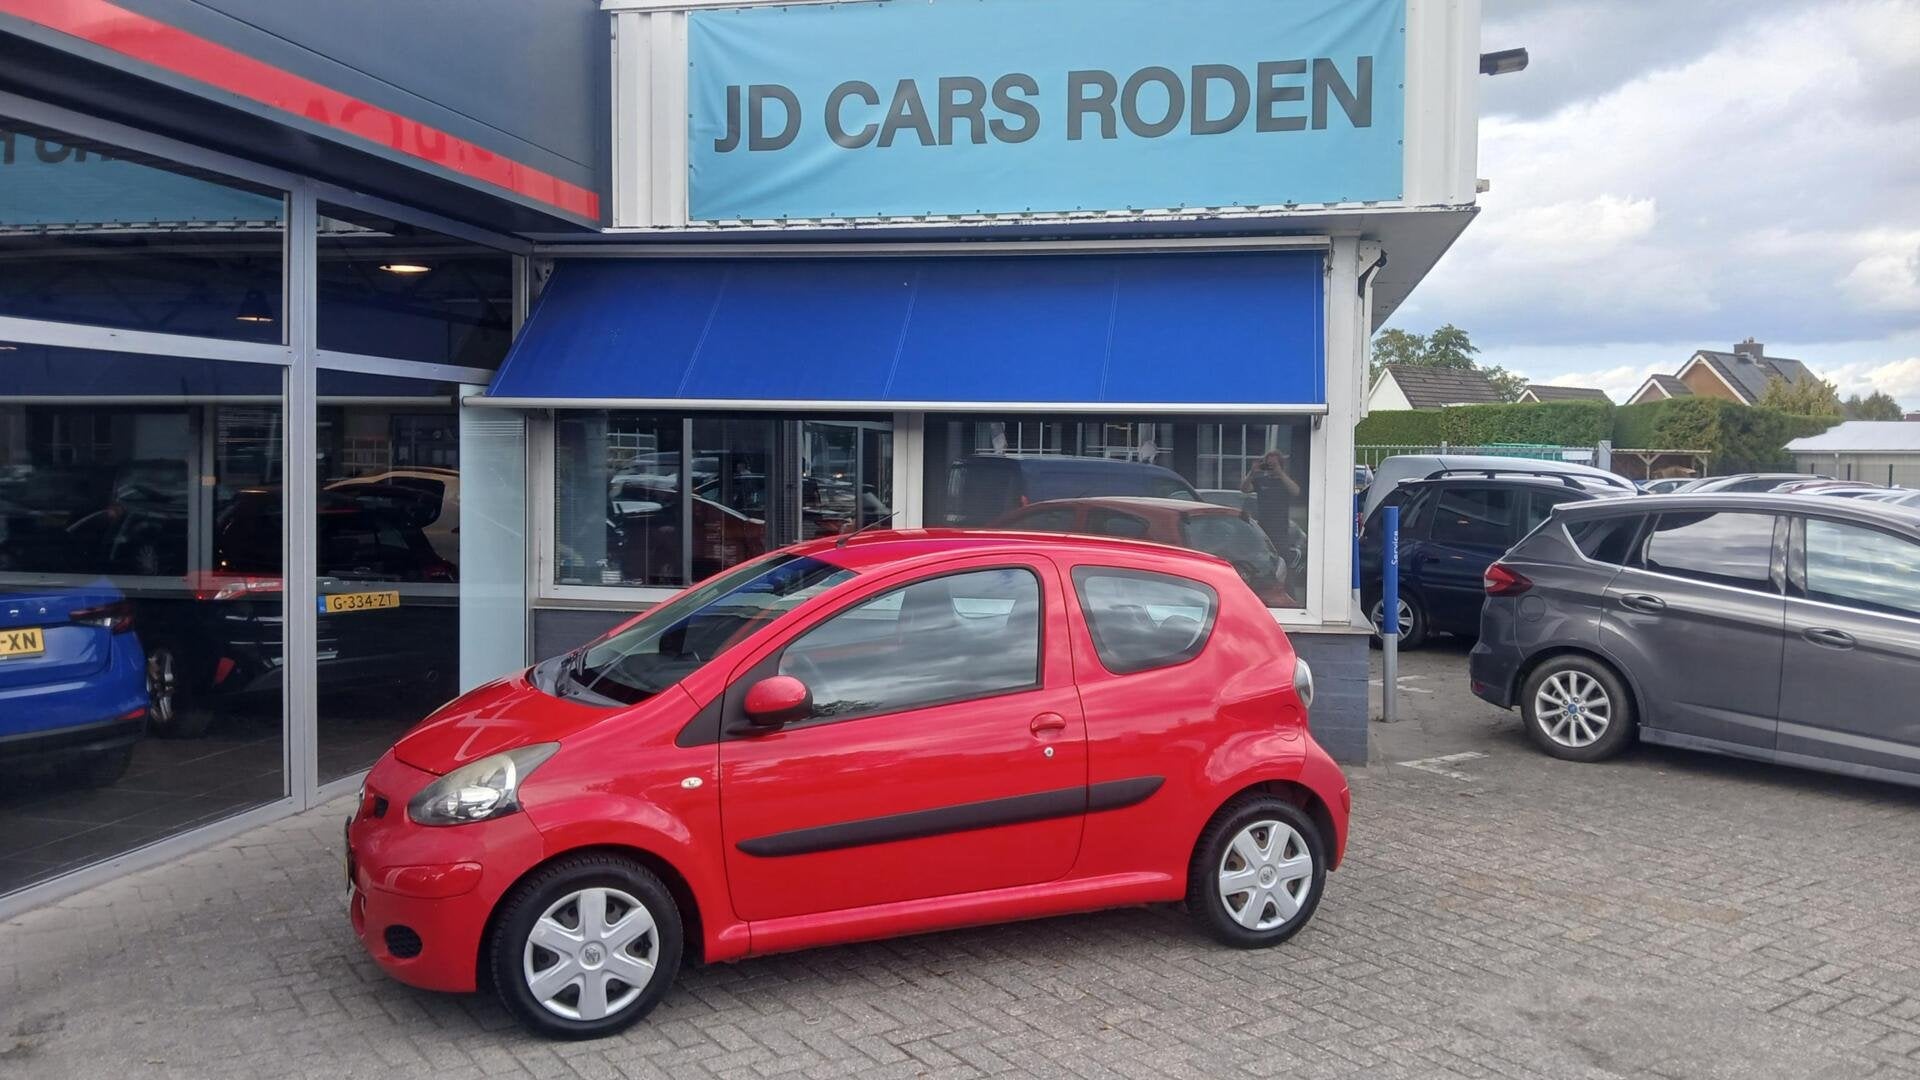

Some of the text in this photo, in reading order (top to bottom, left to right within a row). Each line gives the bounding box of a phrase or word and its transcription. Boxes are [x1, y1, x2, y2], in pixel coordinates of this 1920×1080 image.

[714, 56, 1374, 153] JD CARS RODEN
[333, 593, 393, 610] G-334-ZT
